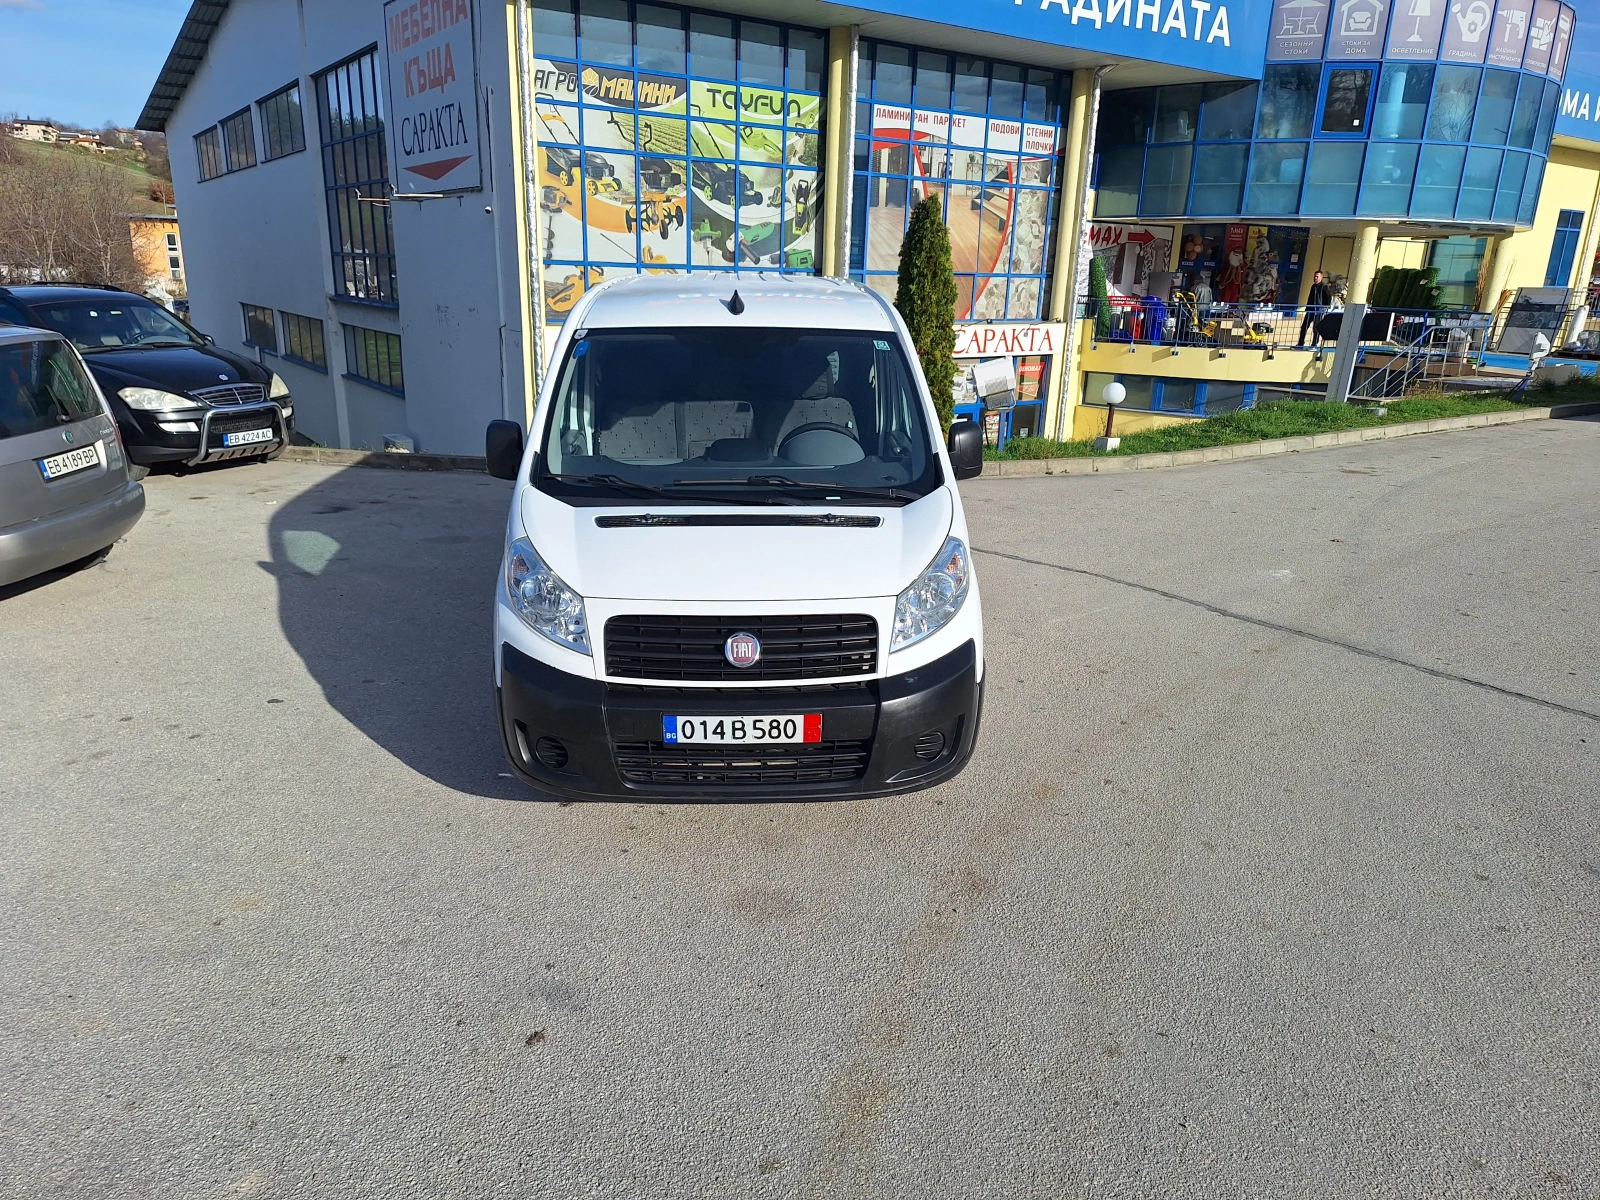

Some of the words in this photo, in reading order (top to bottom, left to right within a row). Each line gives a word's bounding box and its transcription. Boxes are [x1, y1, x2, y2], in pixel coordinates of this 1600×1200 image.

[389, 0, 468, 54] МЕБЕЛНА
[1279, 40, 1314, 48] СЕЗОННИ
[1448, 49, 1477, 58] ГРАДИНА
[403, 42, 456, 98] КЪЩА
[534, 69, 578, 93] АГРО
[600, 76, 677, 105] МАШИНИ
[1559, 88, 1590, 121] МА
[401, 100, 468, 156] САРАКТА
[990, 122, 1020, 136] ПОДОВИ
[1026, 126, 1053, 139] СТЕННИ
[1025, 140, 1054, 152] ПЛОЧКИ
[228, 434, 240, 445] EB
[241, 431, 260, 442] 4224
[261, 429, 271, 440] AC
[46, 459, 62, 475] EB
[62, 452, 84, 470] 4189
[82, 448, 95, 464] BP
[733, 642, 753, 659] FIAT
[666, 732, 677, 740] BG
